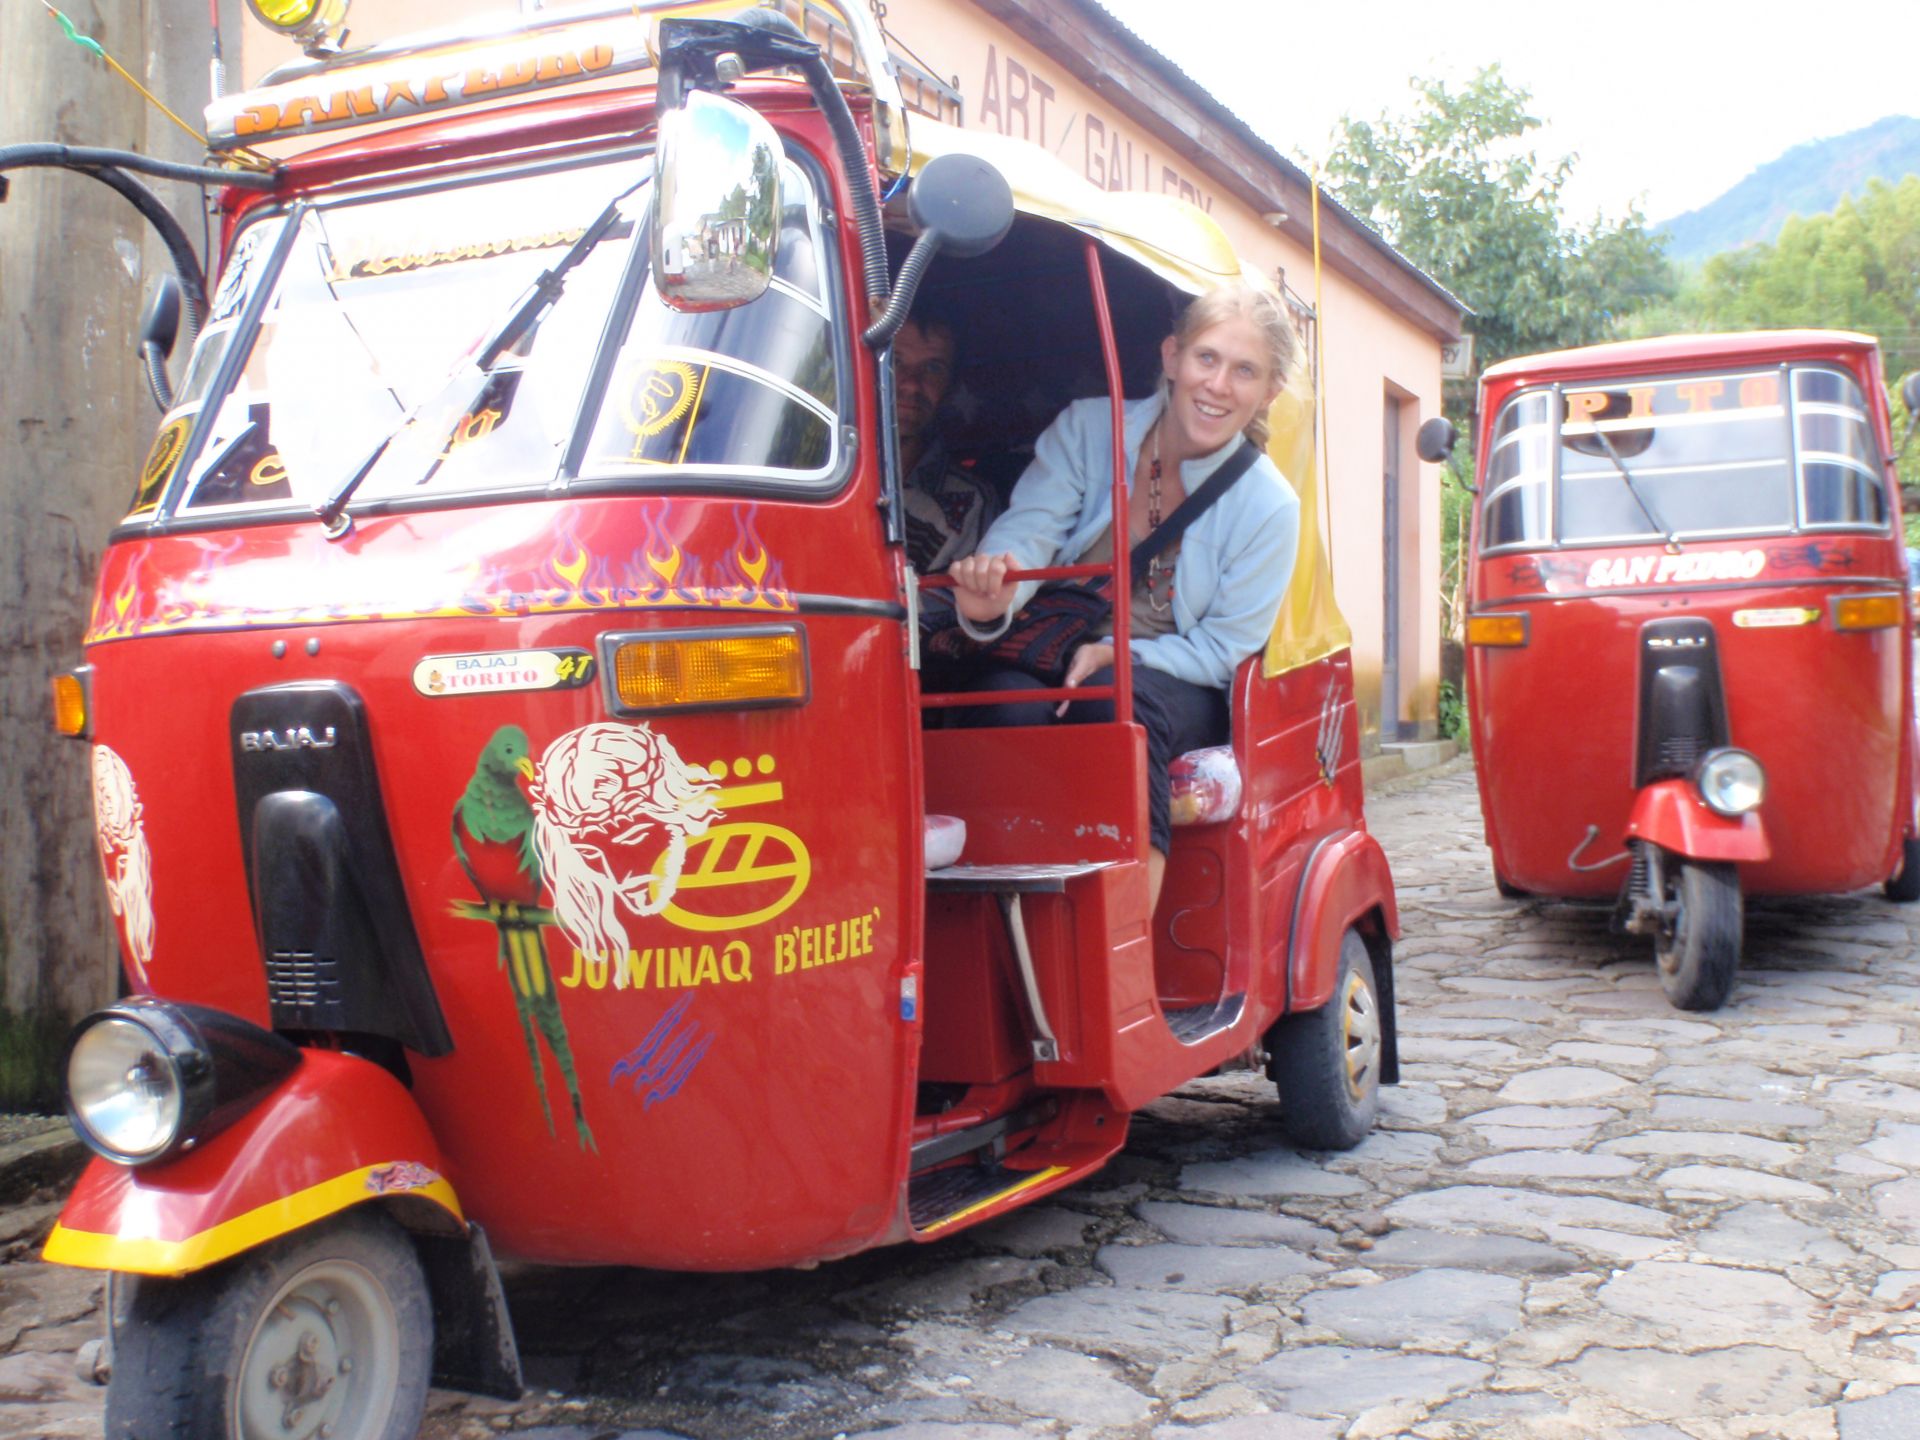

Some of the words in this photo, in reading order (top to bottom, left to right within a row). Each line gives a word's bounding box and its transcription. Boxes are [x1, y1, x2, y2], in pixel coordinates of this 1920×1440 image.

[979, 43, 1055, 149] ART
[1565, 377, 1780, 426] PITO
[1585, 556, 1657, 589] SAN
[1654, 549, 1766, 584] PEDRO
[456, 656, 518, 671] BAJAJ
[555, 655, 593, 681] 4T
[446, 670, 539, 689] TORITO
[241, 727, 336, 752] BAJAJ
